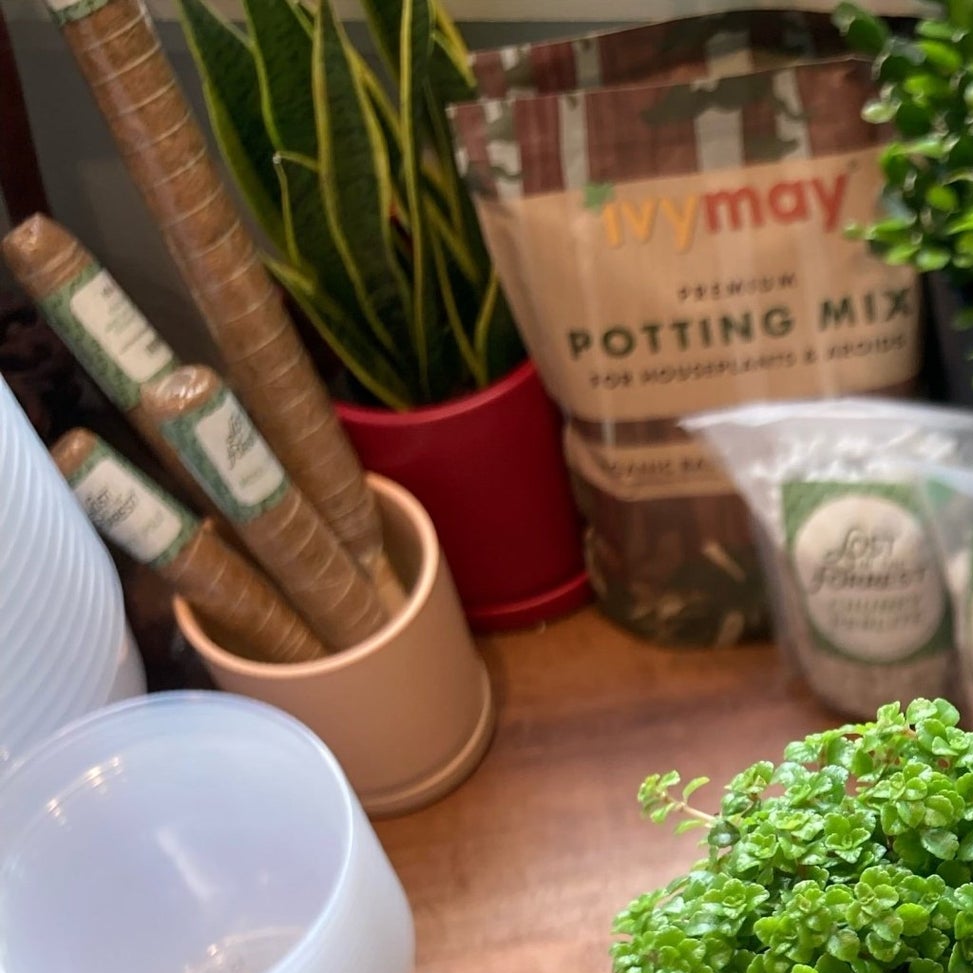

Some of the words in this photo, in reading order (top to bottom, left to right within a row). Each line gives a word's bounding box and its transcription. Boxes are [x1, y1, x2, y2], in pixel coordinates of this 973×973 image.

[601, 173, 848, 251] ivymay
[677, 272, 796, 300] PREMIUM
[567, 303, 796, 361] POTTING
[818, 286, 914, 332] MIX
[589, 368, 633, 390] FOR
[639, 351, 797, 385] HOUSEPLANTS
